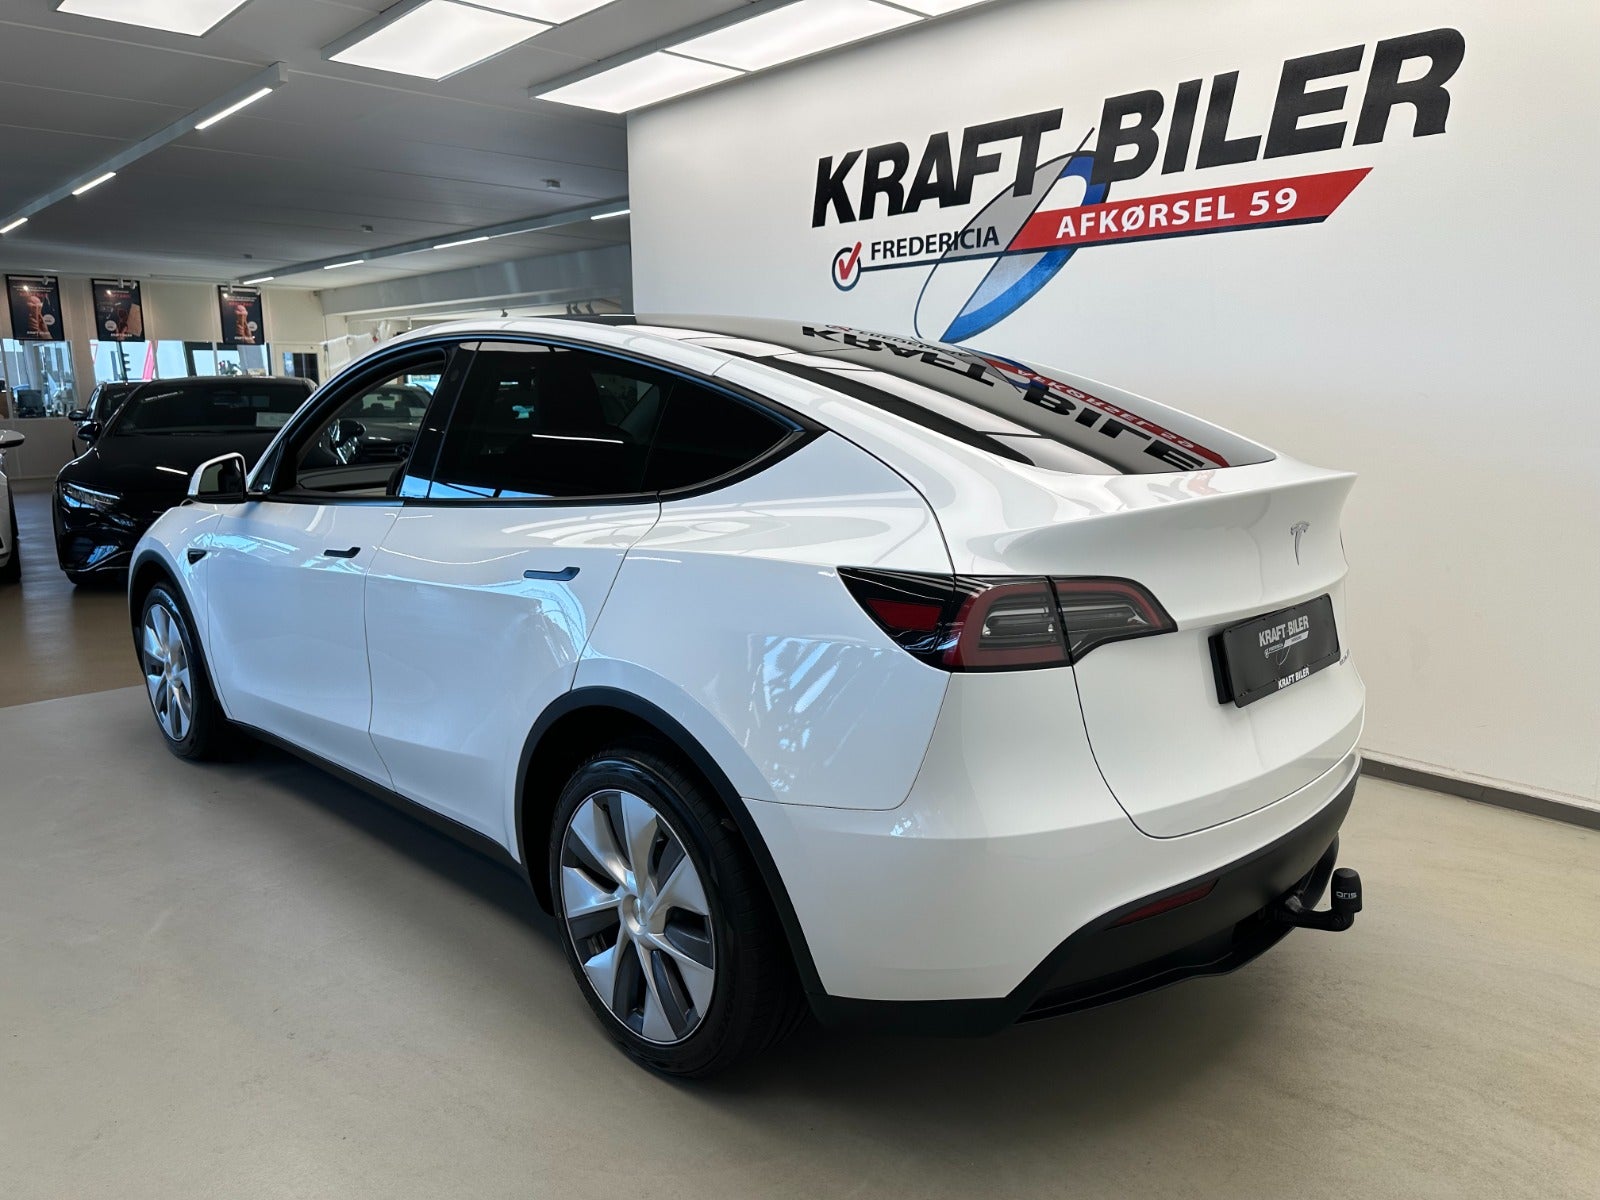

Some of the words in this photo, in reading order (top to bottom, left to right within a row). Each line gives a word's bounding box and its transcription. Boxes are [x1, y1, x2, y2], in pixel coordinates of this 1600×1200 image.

[812, 108, 1063, 228] KRAFT
[1091, 28, 1466, 185] BILER
[1056, 195, 1235, 239] AFKØRSEL
[1249, 187, 1298, 217] 59
[870, 226, 1000, 261] FREDERICIA
[1258, 624, 1286, 647] KRAFT
[1288, 615, 1309, 635] BILER
[1278, 674, 1294, 689] KRAFT
[1295, 667, 1310, 681] BILER
